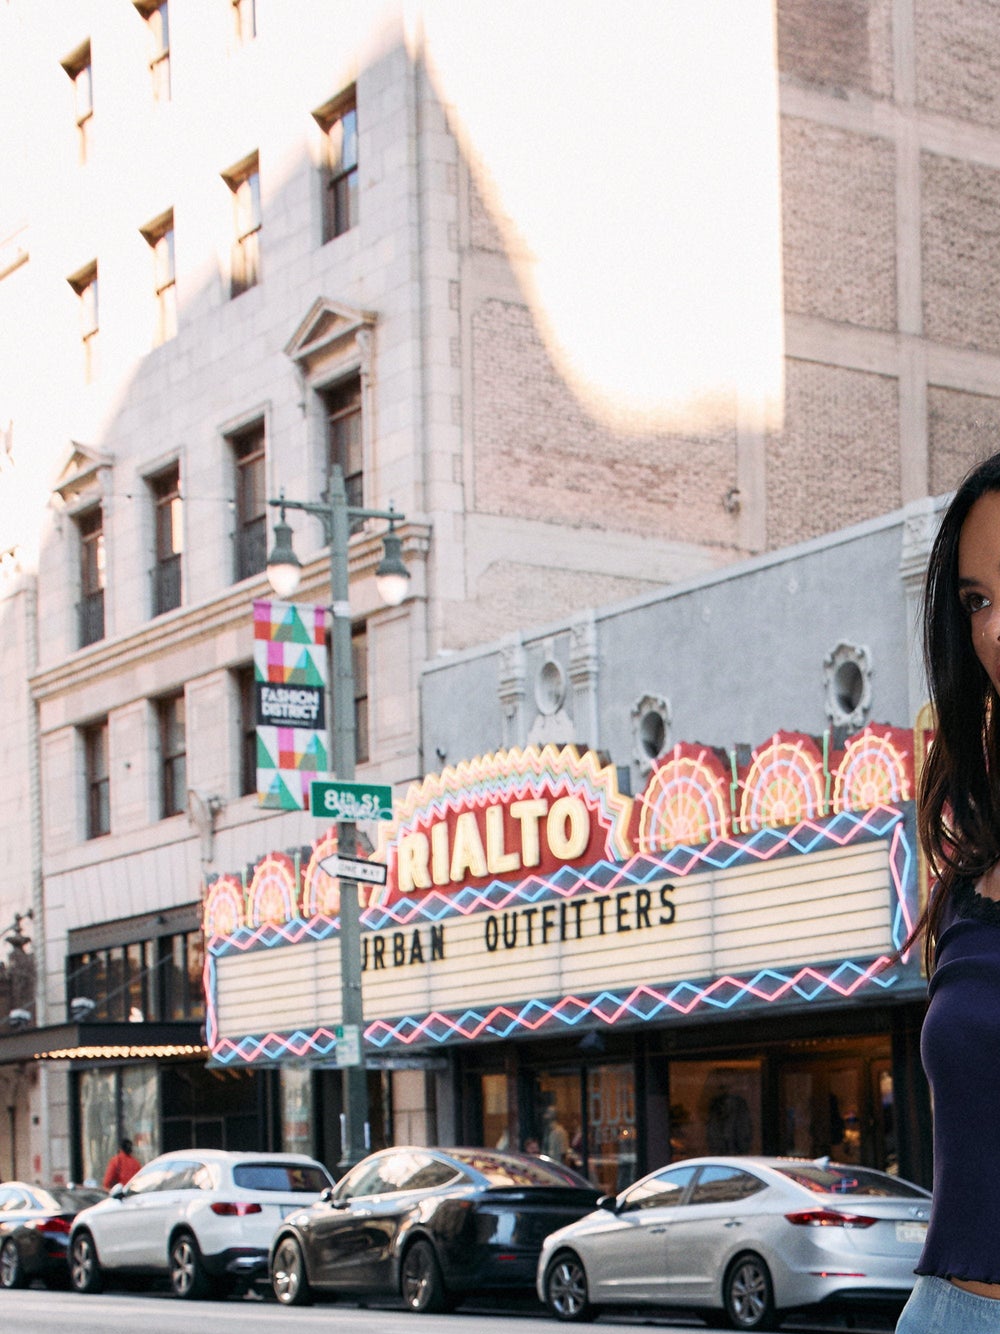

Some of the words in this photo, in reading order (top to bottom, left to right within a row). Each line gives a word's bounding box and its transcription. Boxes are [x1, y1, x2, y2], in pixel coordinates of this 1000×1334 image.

[261, 687, 319, 704] FASHION
[261, 702, 319, 719] DISTRICT
[398, 796, 590, 892] RIALTO
[338, 862, 357, 875] ONE
[360, 866, 381, 880] WAY
[485, 884, 676, 952] OUTFITTERS
